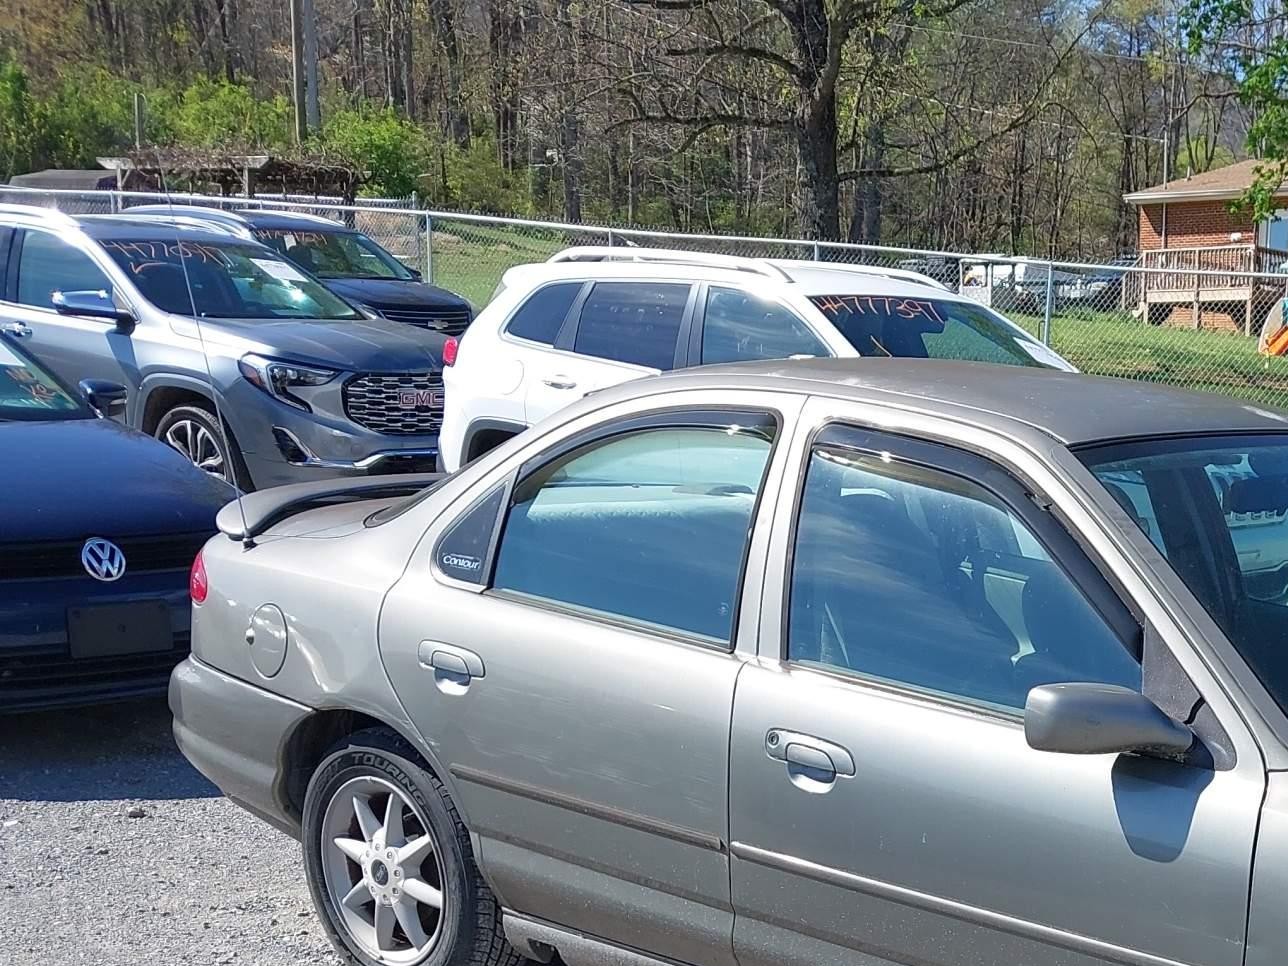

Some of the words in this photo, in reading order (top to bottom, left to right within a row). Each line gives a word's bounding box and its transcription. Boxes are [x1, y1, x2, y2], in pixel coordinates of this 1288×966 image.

[400, 390, 444, 409] GMC
[443, 554, 480, 569] Contour
[351, 753, 427, 807] TOURING
